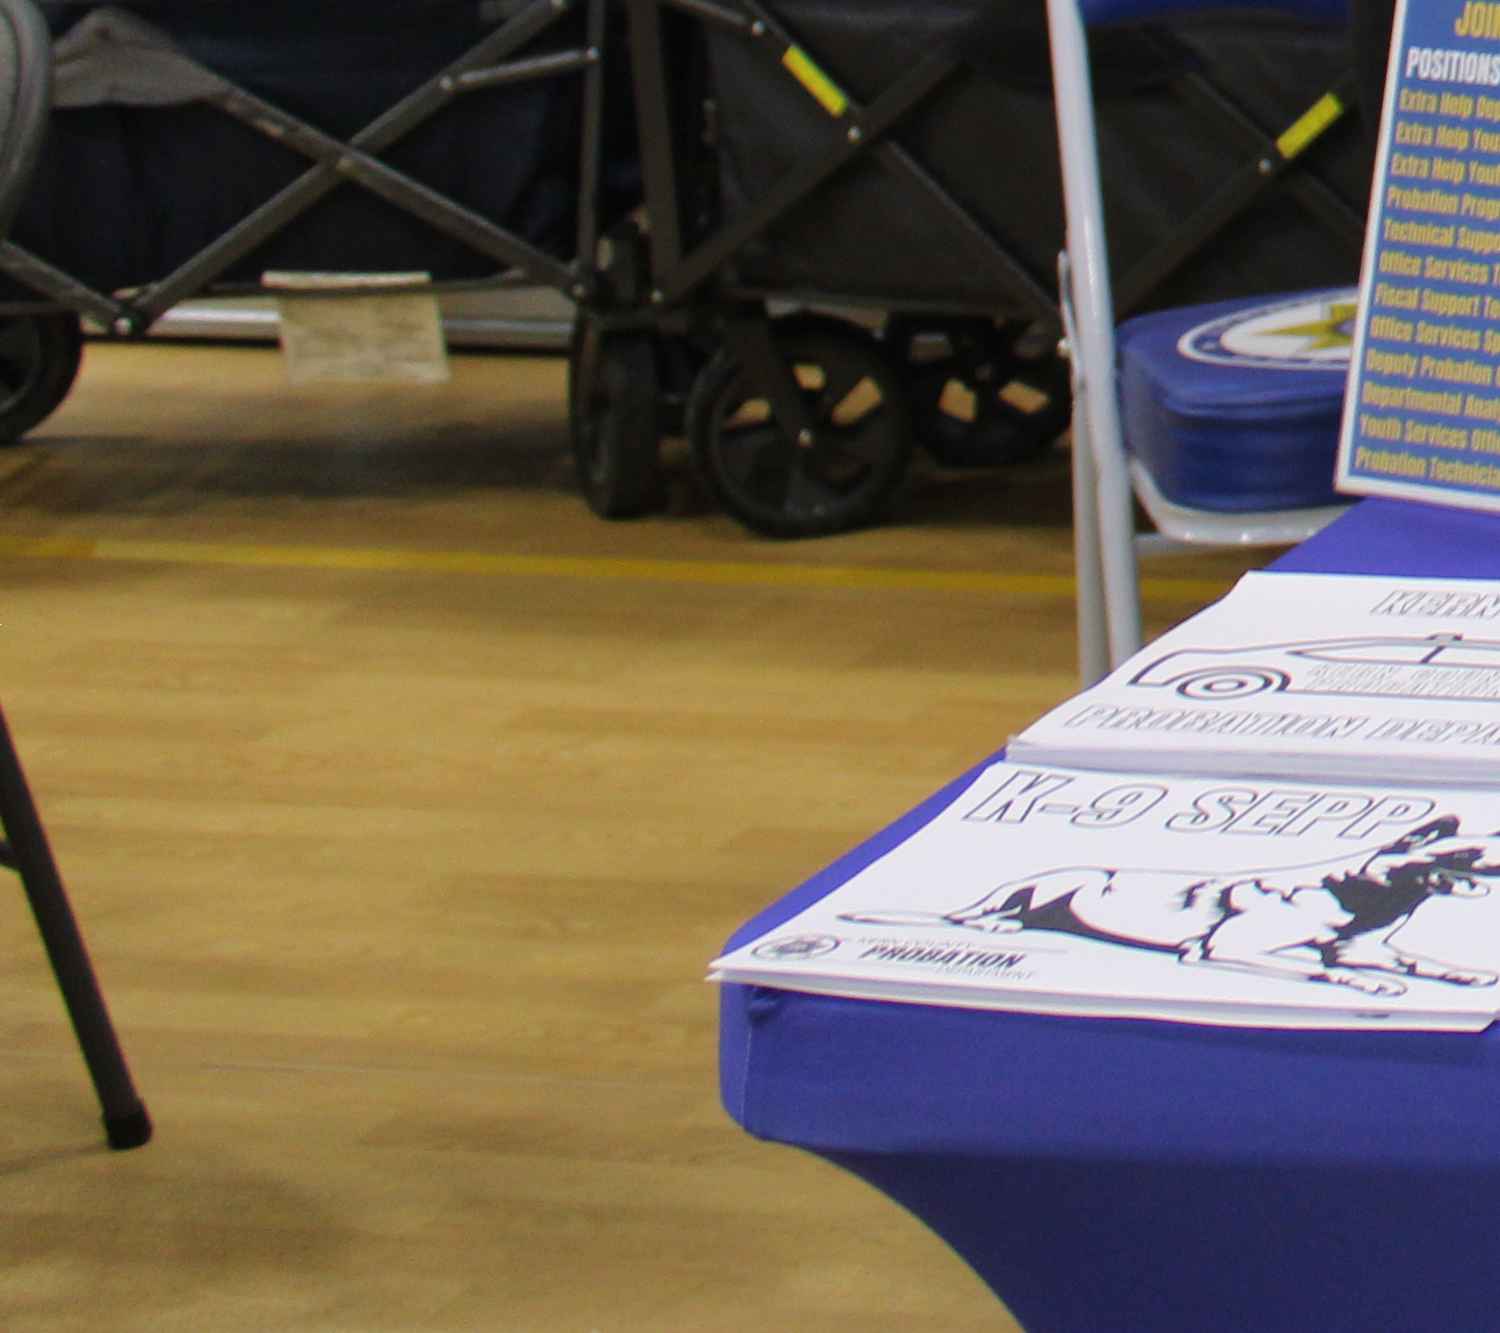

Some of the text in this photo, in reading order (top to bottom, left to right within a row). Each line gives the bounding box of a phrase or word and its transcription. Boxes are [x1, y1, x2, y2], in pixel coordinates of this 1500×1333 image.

[1399, 88, 1438, 114] Extra
[1440, 92, 1473, 119] Help
[1395, 121, 1433, 146] Extra
[1436, 125, 1469, 152] Help
[1390, 153, 1430, 178] Extra
[1432, 157, 1466, 184] Help
[1385, 185, 1459, 215] Probation
[1384, 218, 1455, 248] Technical
[1379, 250, 1422, 275] Office
[1424, 255, 1490, 284] Services
[1374, 283, 1420, 310] Fiscal
[1421, 288, 1481, 317] Support
[1370, 315, 1414, 342] Office
[1415, 320, 1481, 351] Services
[1365, 348, 1418, 379] Deputy
[1419, 355, 1493, 385] Probation
[1362, 381, 1463, 416] Departmental
[1359, 413, 1401, 440] Youth
[1404, 419, 1468, 449] Services
[1354, 445, 1427, 478] Probation
[1063, 704, 1370, 740] PROBATION
[961, 770, 1437, 840] K-9 SEPP
[857, 944, 1028, 969] PROBATION
